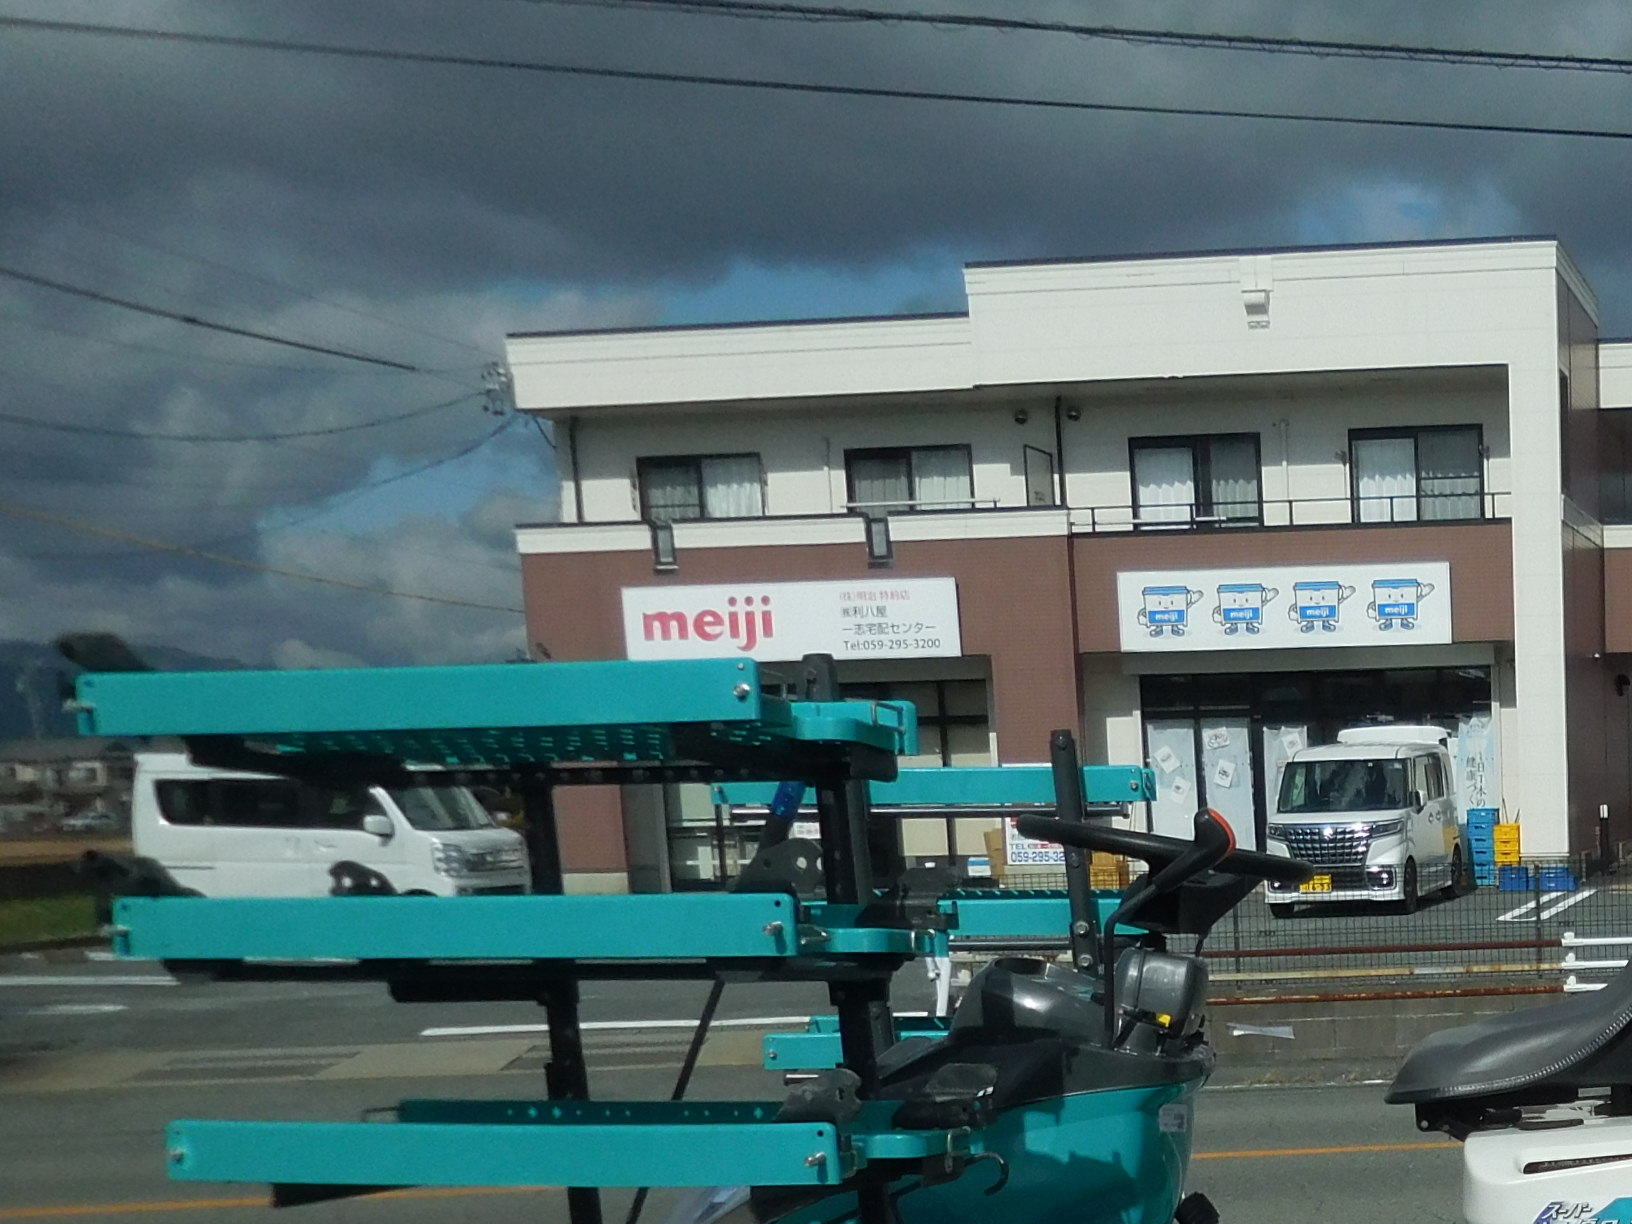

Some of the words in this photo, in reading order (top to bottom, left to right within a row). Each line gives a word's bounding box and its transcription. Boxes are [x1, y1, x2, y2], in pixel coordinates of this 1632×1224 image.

[1230, 608, 1253, 620] meiji
[1306, 606, 1330, 617] meiji
[1385, 604, 1408, 615] meiji
[1155, 611, 1179, 622] meiji
[642, 595, 774, 652] meiji
[842, 621, 936, 636] 一志宅配センター
[1011, 851, 1066, 863] 059-295-32
[1541, 1202, 1592, 1220] スーパー
